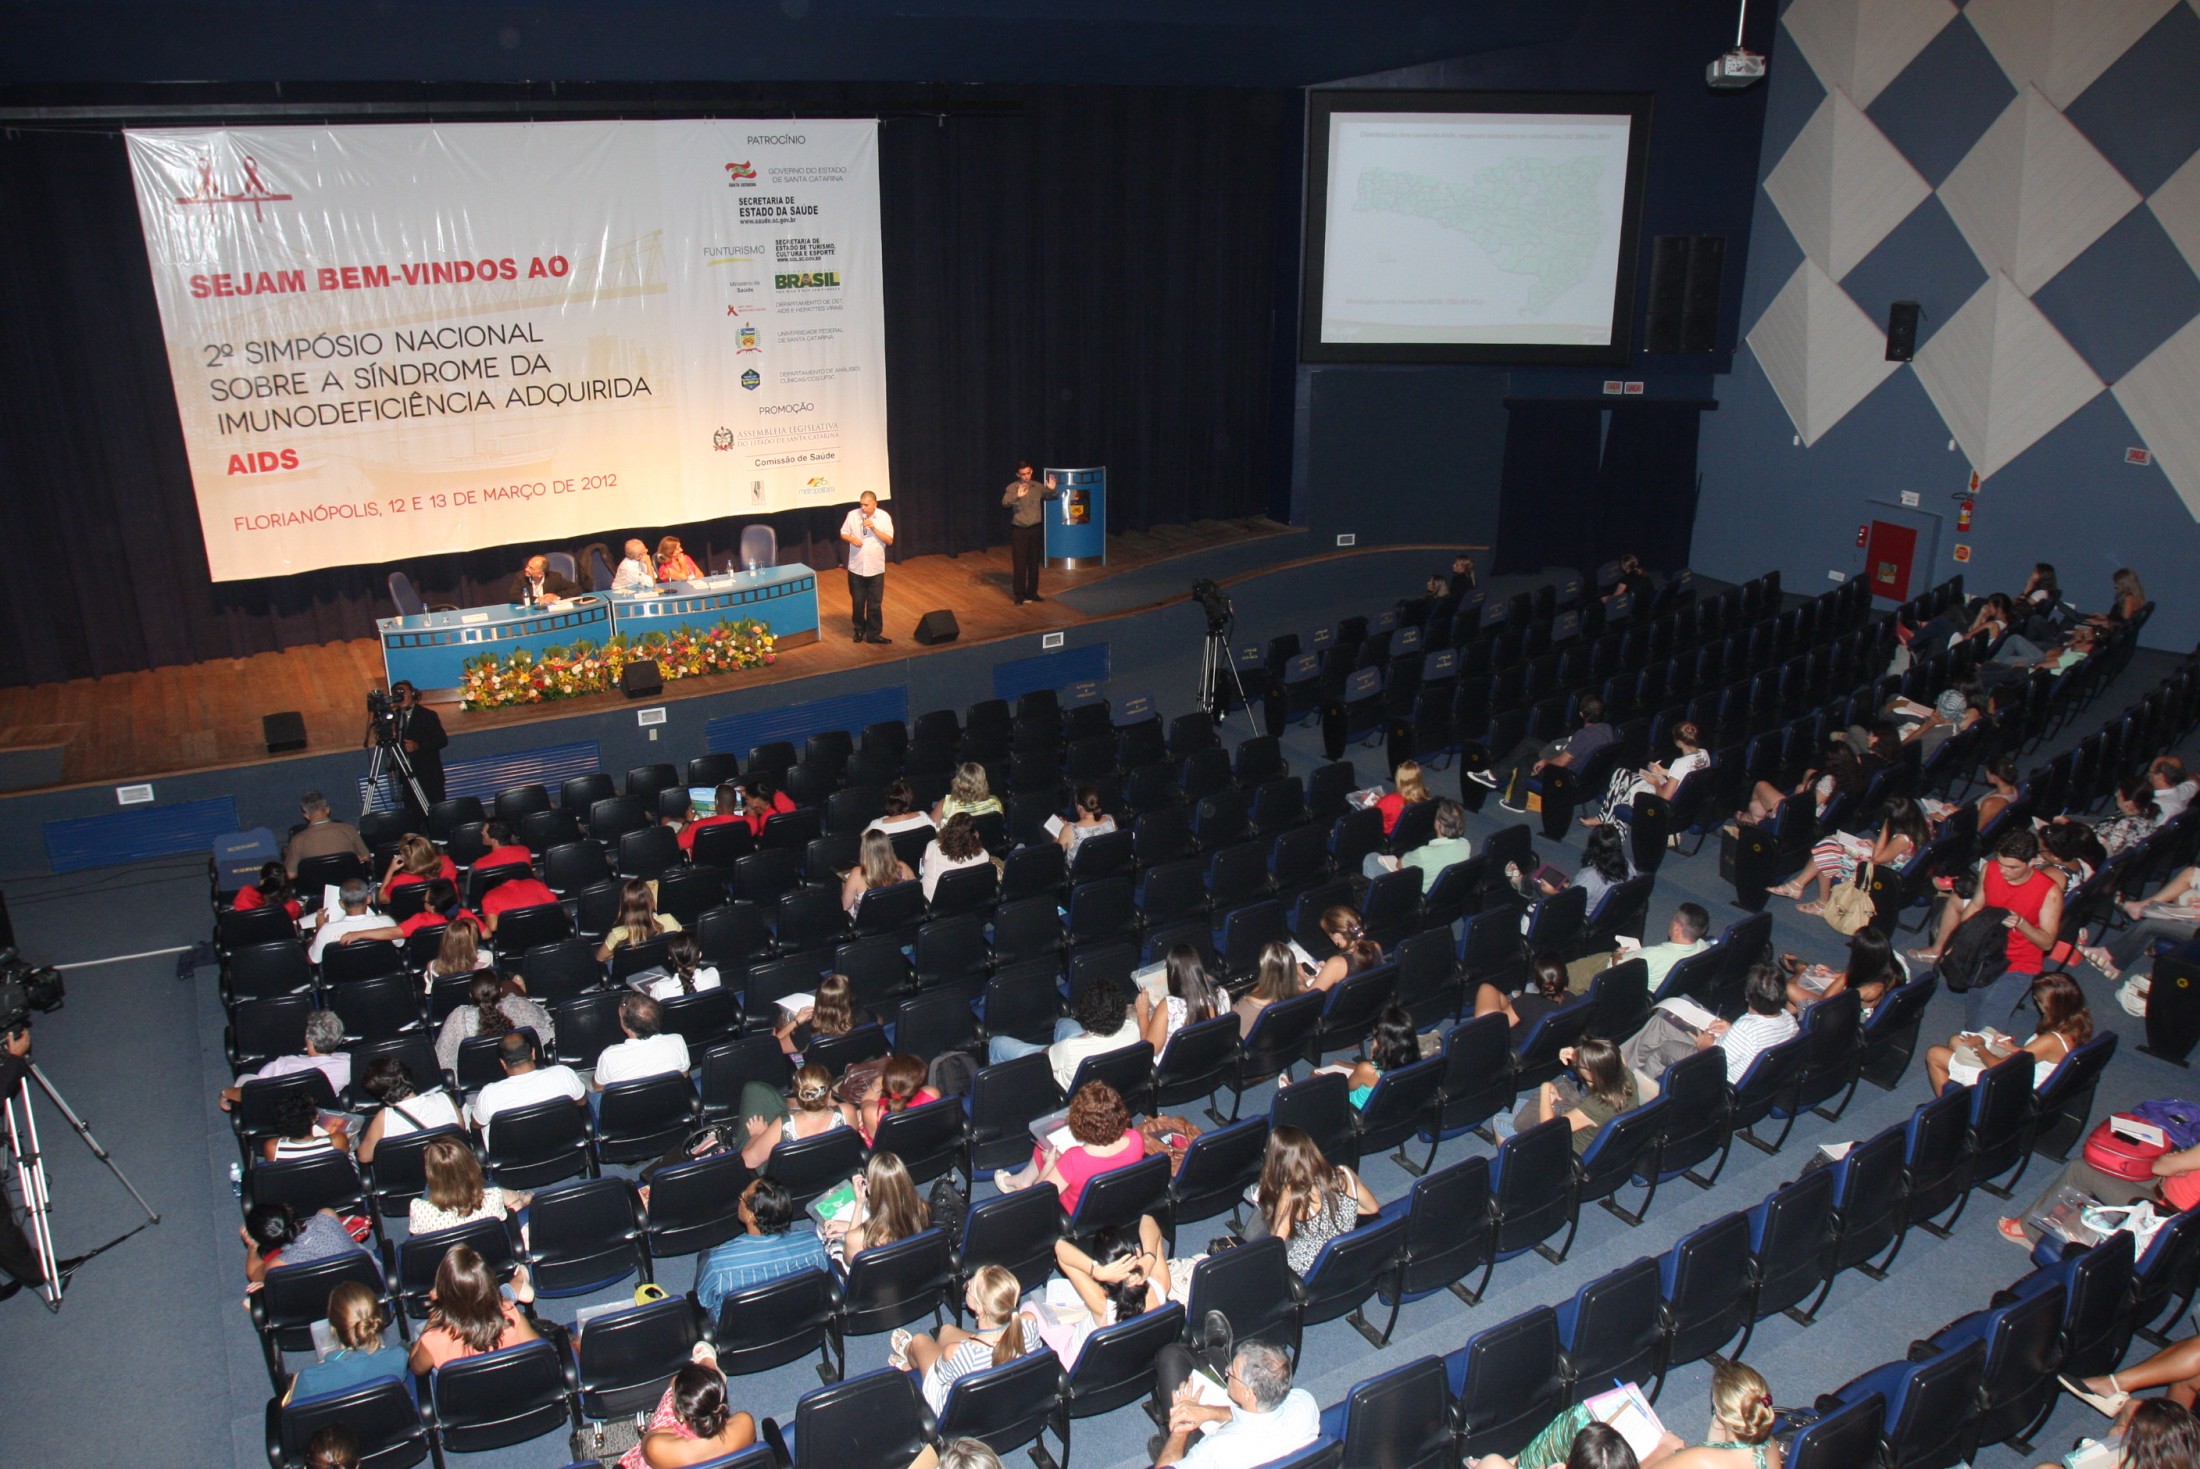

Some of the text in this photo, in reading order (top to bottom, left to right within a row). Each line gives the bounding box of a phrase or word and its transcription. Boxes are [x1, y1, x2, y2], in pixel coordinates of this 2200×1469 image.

[747, 134, 806, 145] PATROCÍNIO
[738, 196, 795, 206] SECRETARIA DE
[739, 204, 819, 217] ESTADO DA SAÚDE
[740, 217, 796, 225] www.saude.sc.gov.br
[775, 238, 811, 246] SECRETARIA
[703, 245, 766, 257] FUNTURISMO
[189, 255, 569, 299] SEJAM BEM-VINDOS AO
[775, 272, 840, 289] BRASIL
[204, 322, 544, 367] 2º SIMPÓSIO NACIONAL
[210, 353, 551, 401] SOBRE A SÍNDROME DA
[218, 376, 652, 435] IMUNODEFICIÊNCIA ADQUIRIDA
[759, 402, 815, 415] PROMOÇÃO
[737, 422, 839, 438] ASSEMBLEIA LEGISLATIVA
[808, 432, 839, 440] CATARINA
[227, 448, 300, 475] AIDS
[754, 457, 796, 467] Comissão
[810, 452, 835, 461] Saúde
[234, 473, 617, 531] FLORIANÓPOLIS, 12 E 13 DE MARÇO DE 2012
